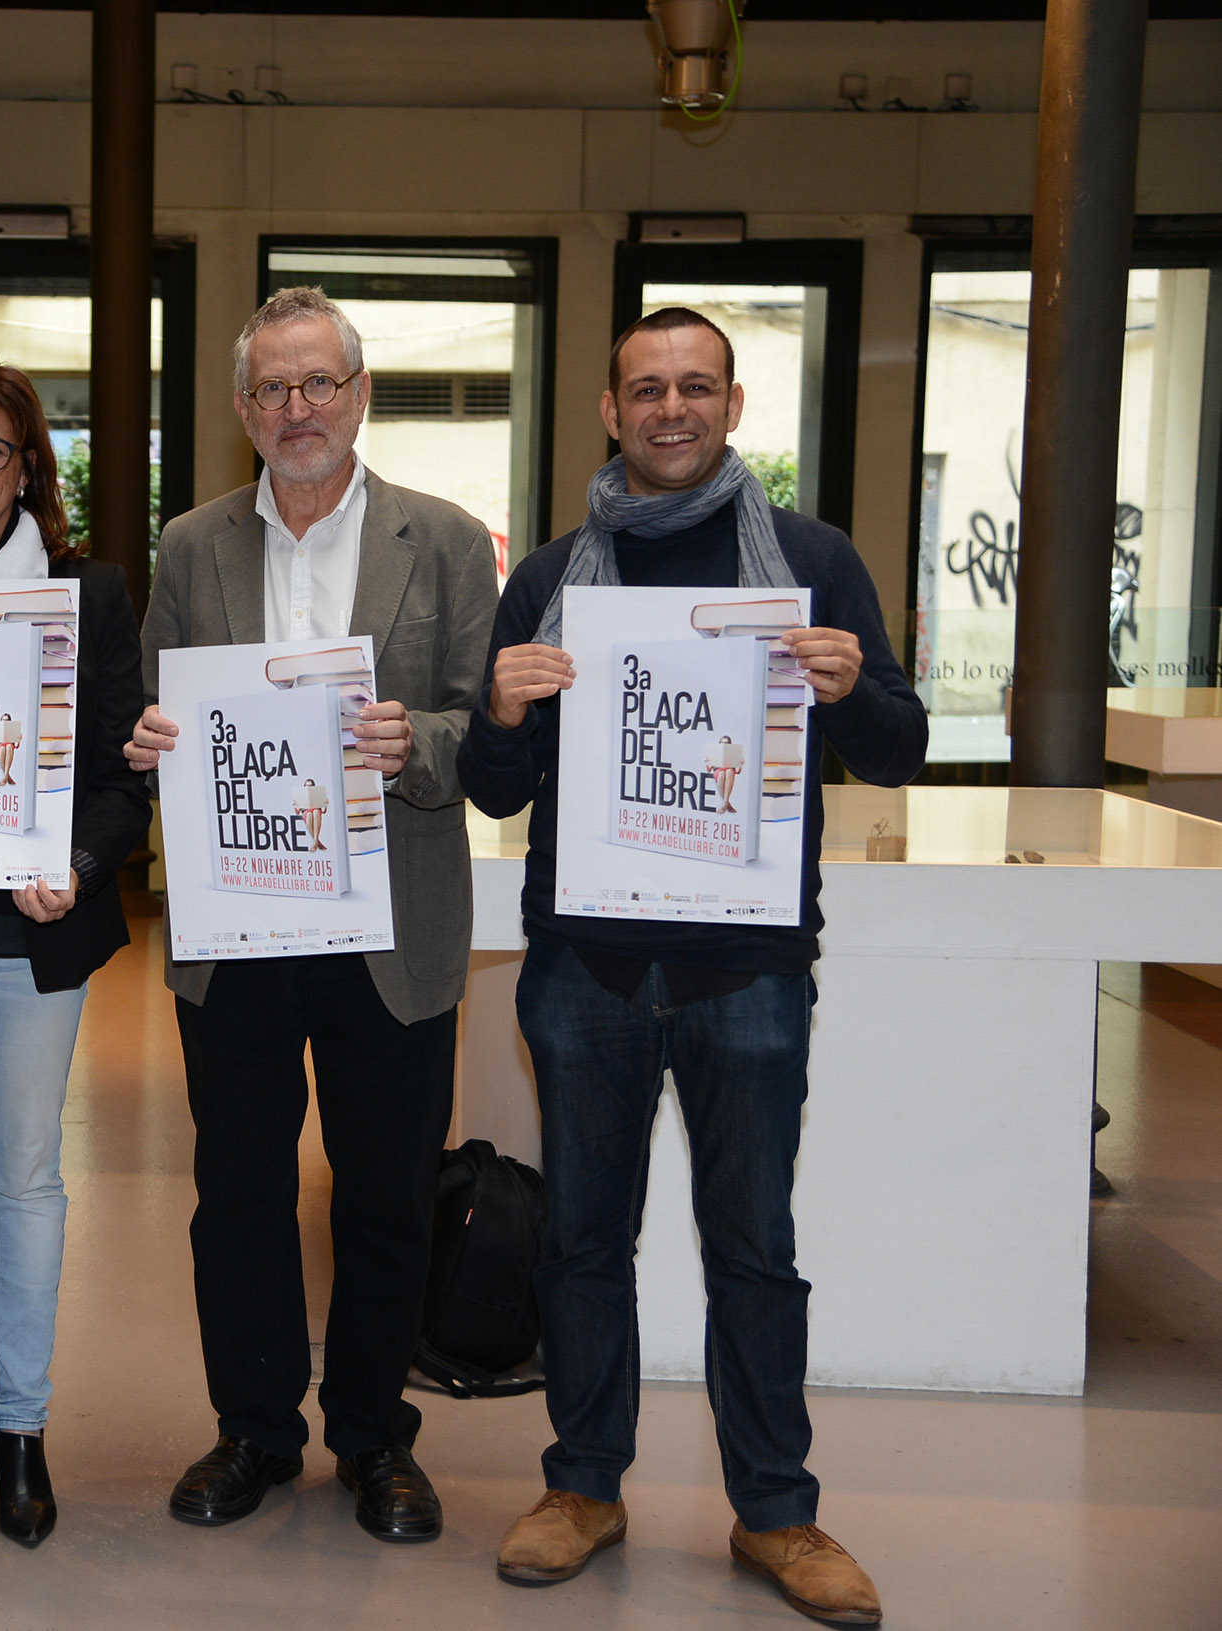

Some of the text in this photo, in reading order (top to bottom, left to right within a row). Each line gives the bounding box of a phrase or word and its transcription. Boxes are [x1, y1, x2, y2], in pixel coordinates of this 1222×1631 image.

[623, 654, 651, 690] 3a
[963, 659, 982, 679] lo
[210, 710, 237, 744] 3a
[622, 691, 714, 734] PLAÇA
[212, 740, 298, 781] PLAÇA
[621, 729, 672, 768] DEL
[214, 779, 263, 815] DEL
[620, 765, 717, 813] LLIBRE
[217, 814, 309, 852] LLIBRE
[619, 808, 740, 842] 19-22 NOVEMBRE 2015
[220, 856, 332, 877] 19-22 NOVEMBRE 2015
